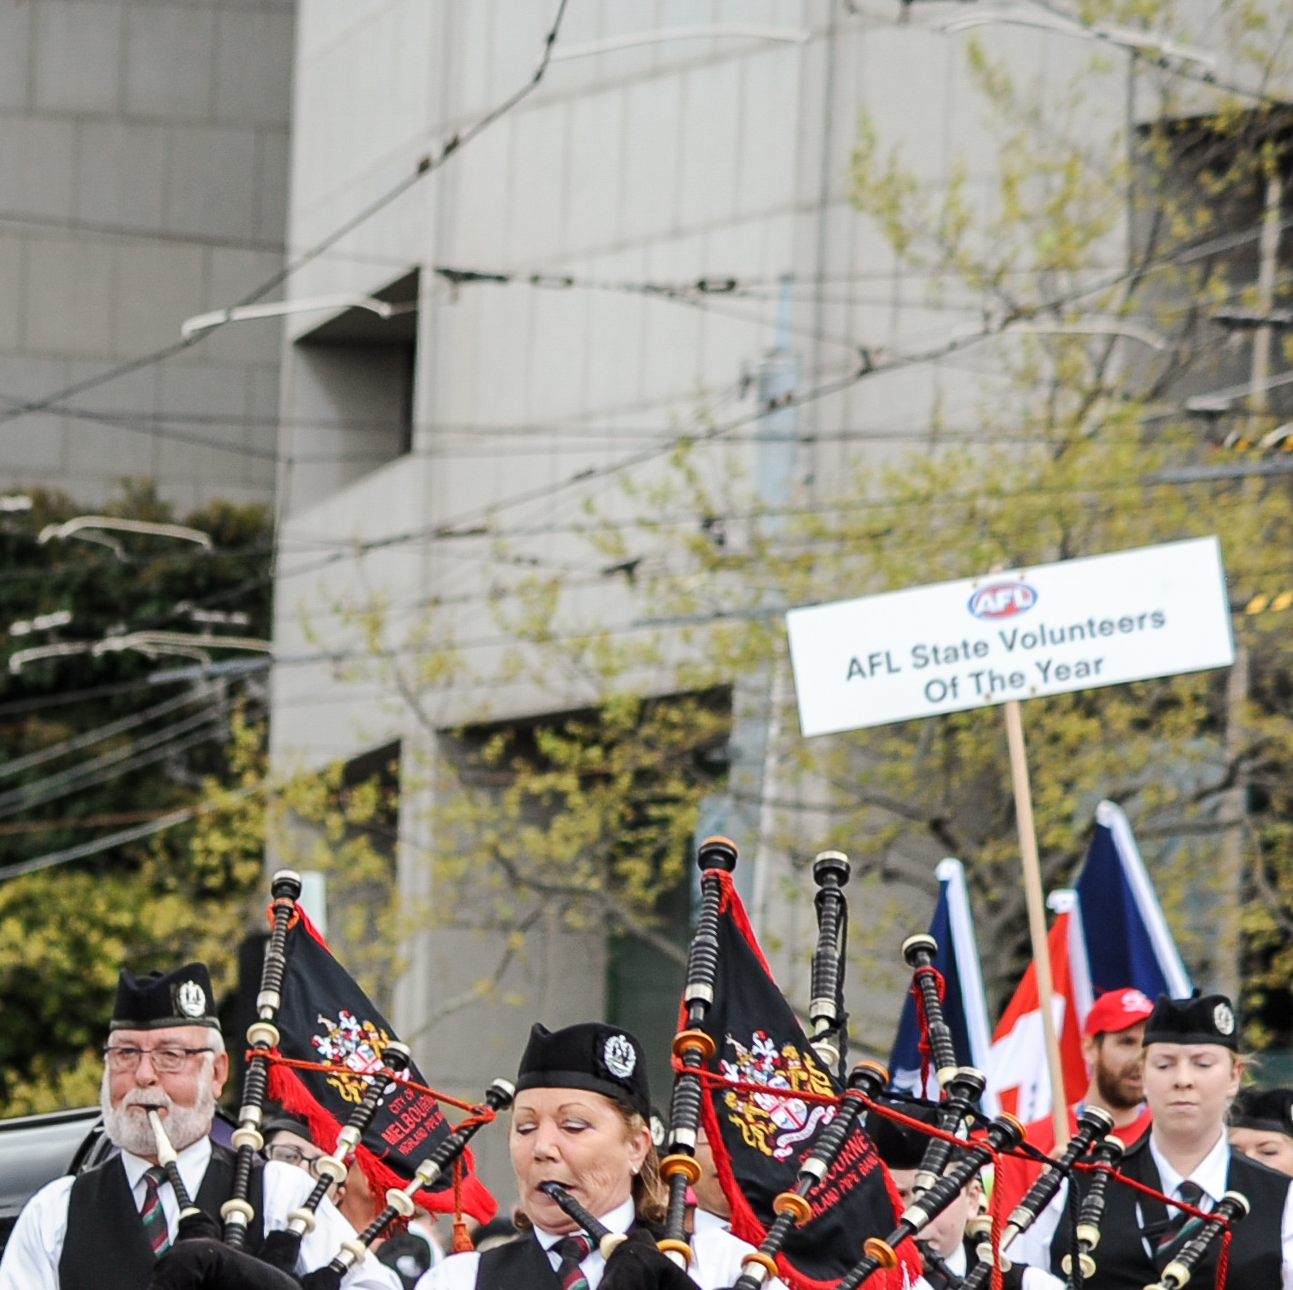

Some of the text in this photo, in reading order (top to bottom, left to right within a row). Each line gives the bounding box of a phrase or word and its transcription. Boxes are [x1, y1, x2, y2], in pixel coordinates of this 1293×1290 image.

[974, 587, 1034, 614] AFL
[845, 609, 1168, 682] AFL State Volunteers
[923, 656, 1105, 704] Of The Year
